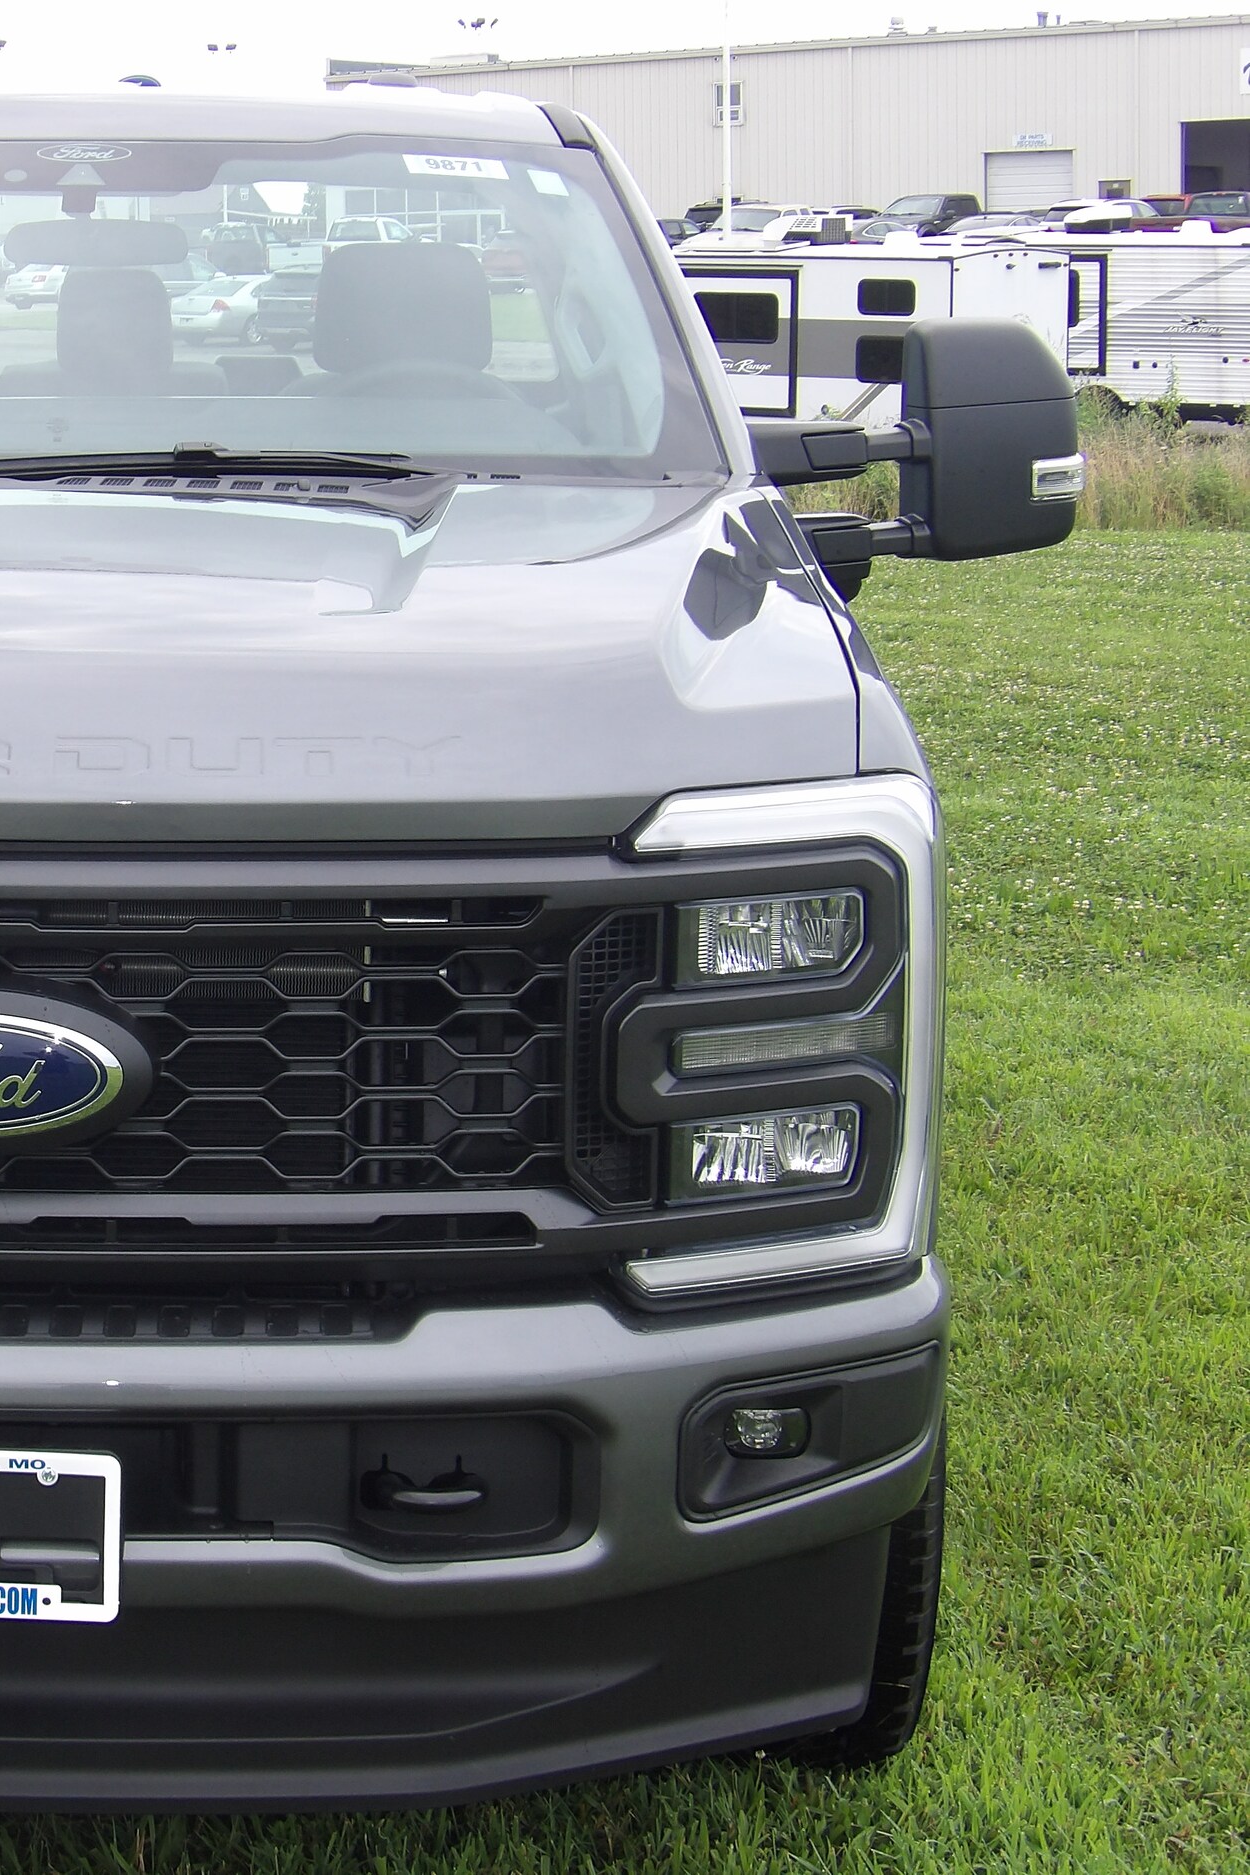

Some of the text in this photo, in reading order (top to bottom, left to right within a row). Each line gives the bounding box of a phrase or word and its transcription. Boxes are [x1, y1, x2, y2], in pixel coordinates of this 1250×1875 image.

[53, 145, 116, 159] Ford
[425, 158, 483, 172] 9871
[734, 358, 772, 376] Range
[53, 735, 461, 777] DUTY
[9, 1458, 51, 1470] MO.
